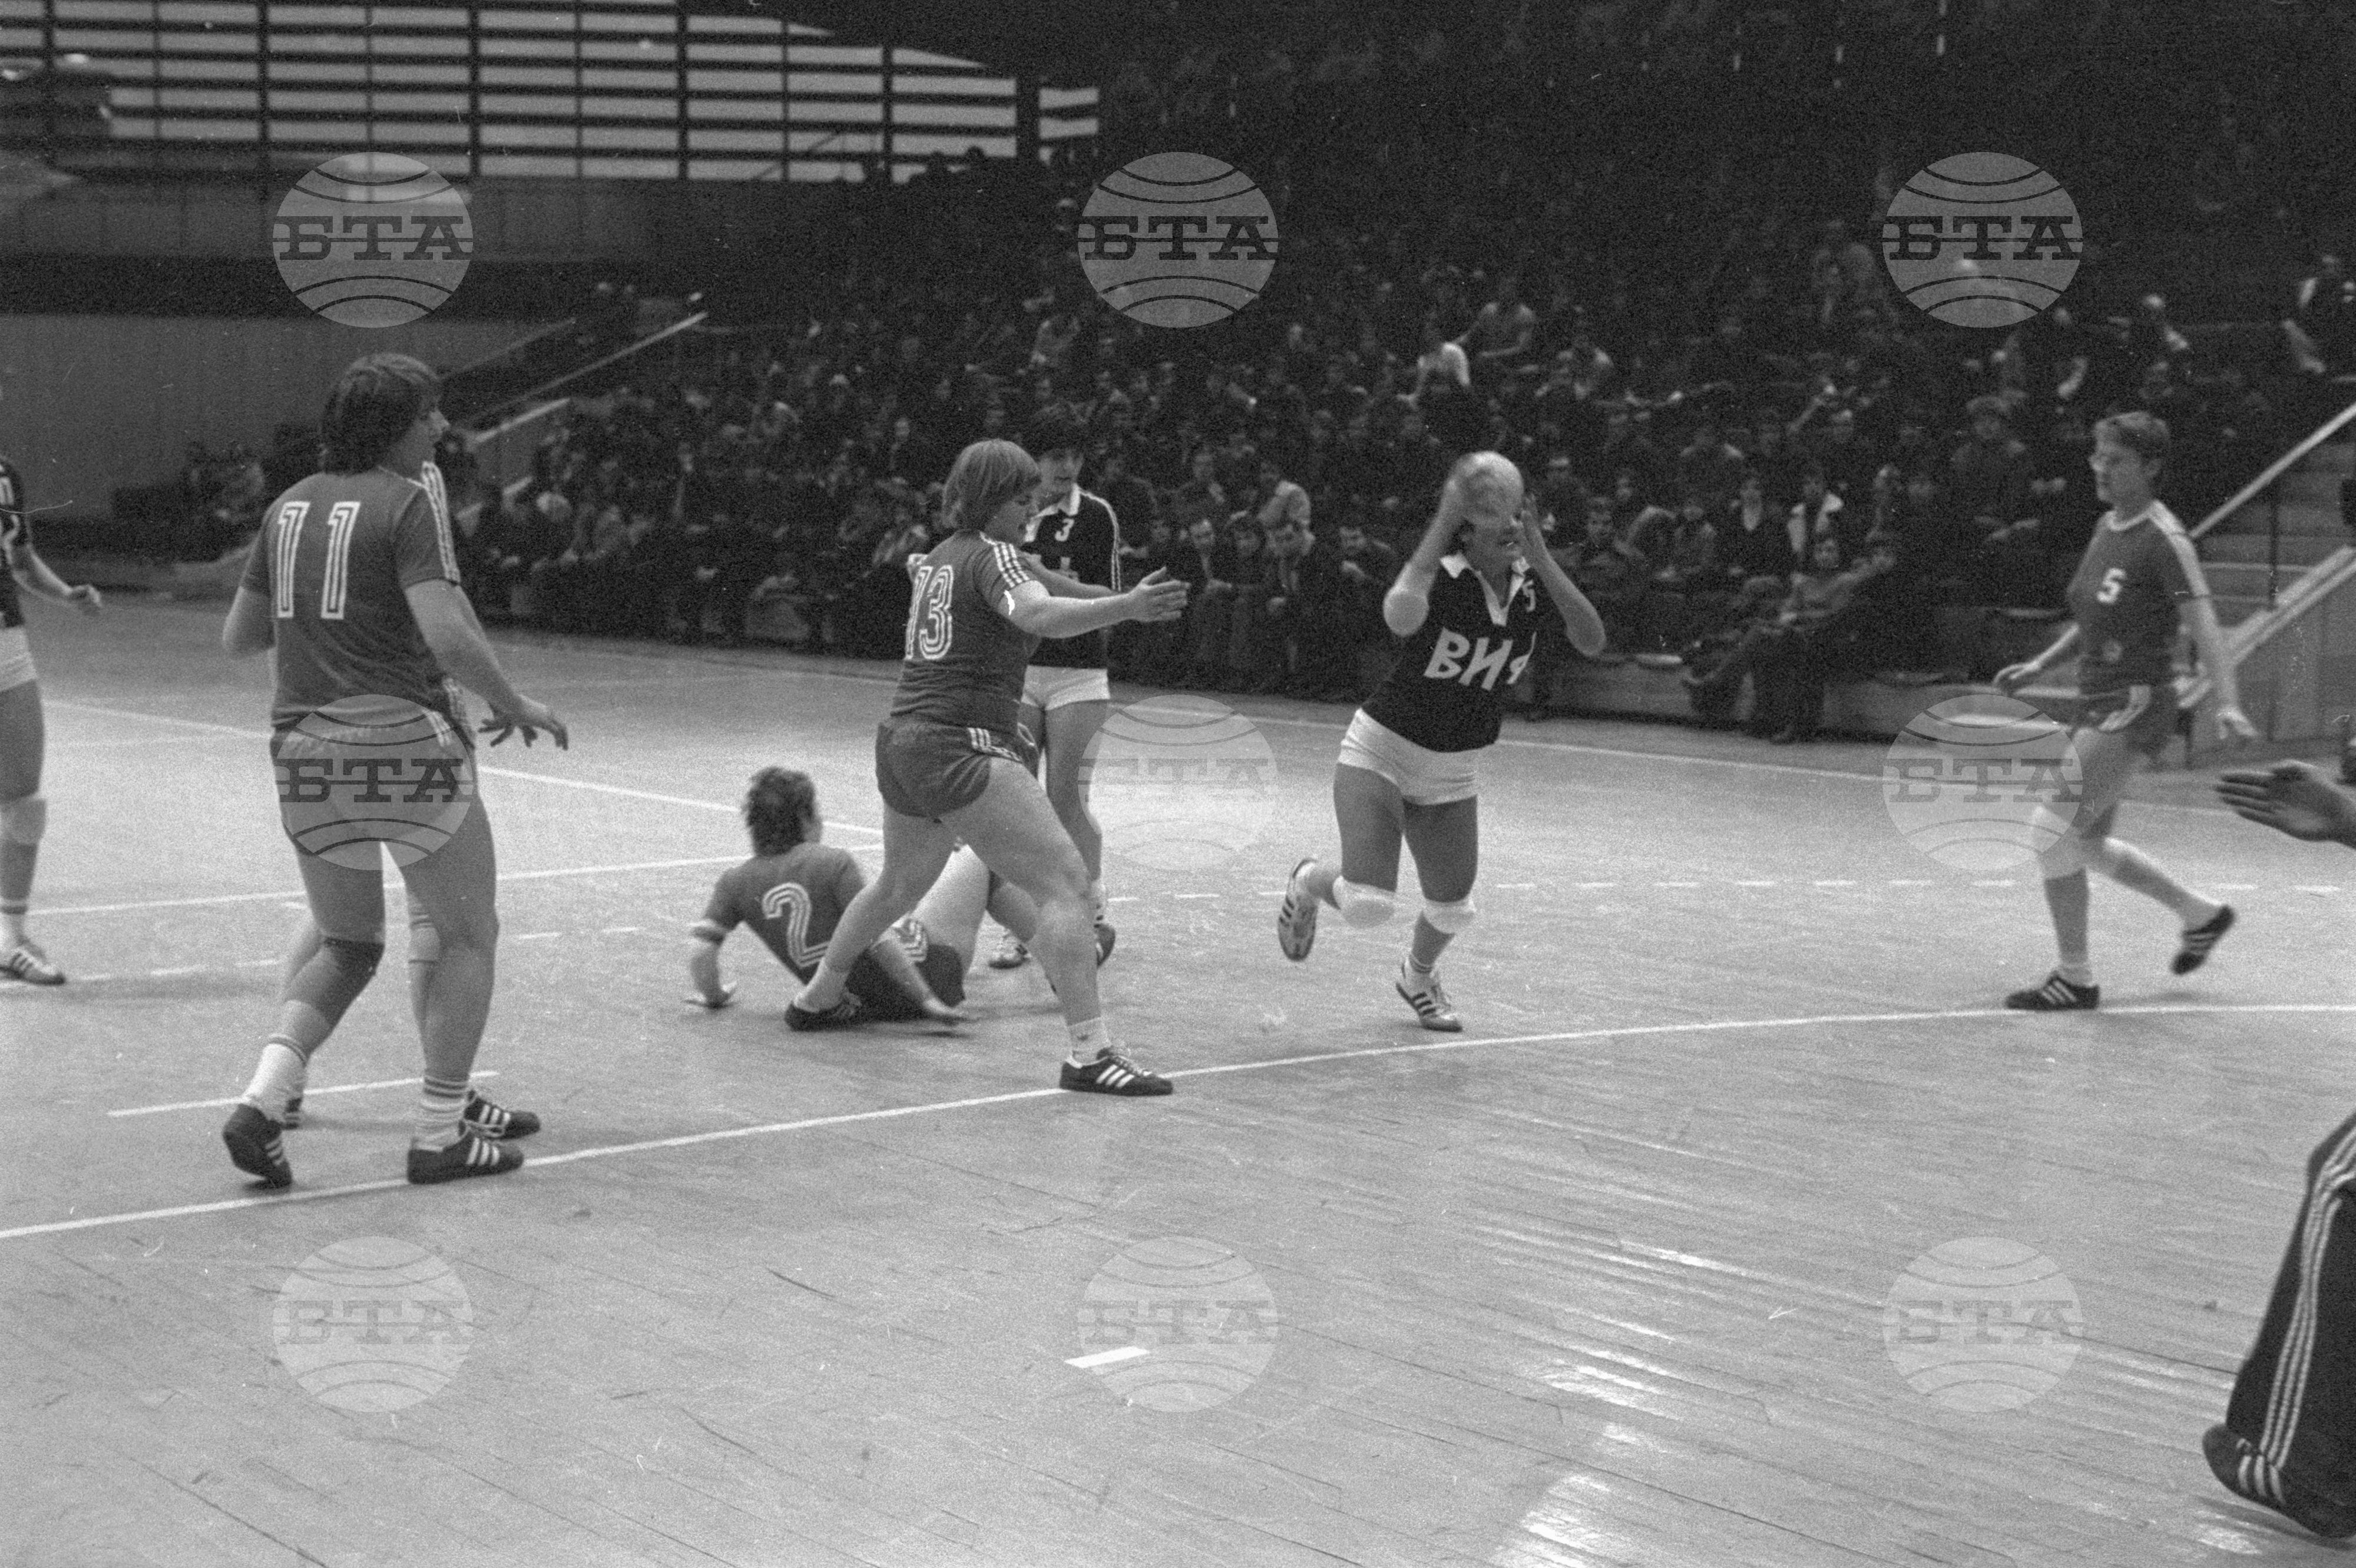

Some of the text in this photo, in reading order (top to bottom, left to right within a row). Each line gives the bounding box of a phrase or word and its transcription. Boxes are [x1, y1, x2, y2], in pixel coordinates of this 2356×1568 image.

[277, 501, 361, 620] 11
[2097, 567, 2126, 603] 5
[904, 565, 954, 660] 13
[762, 882, 828, 967] 2
